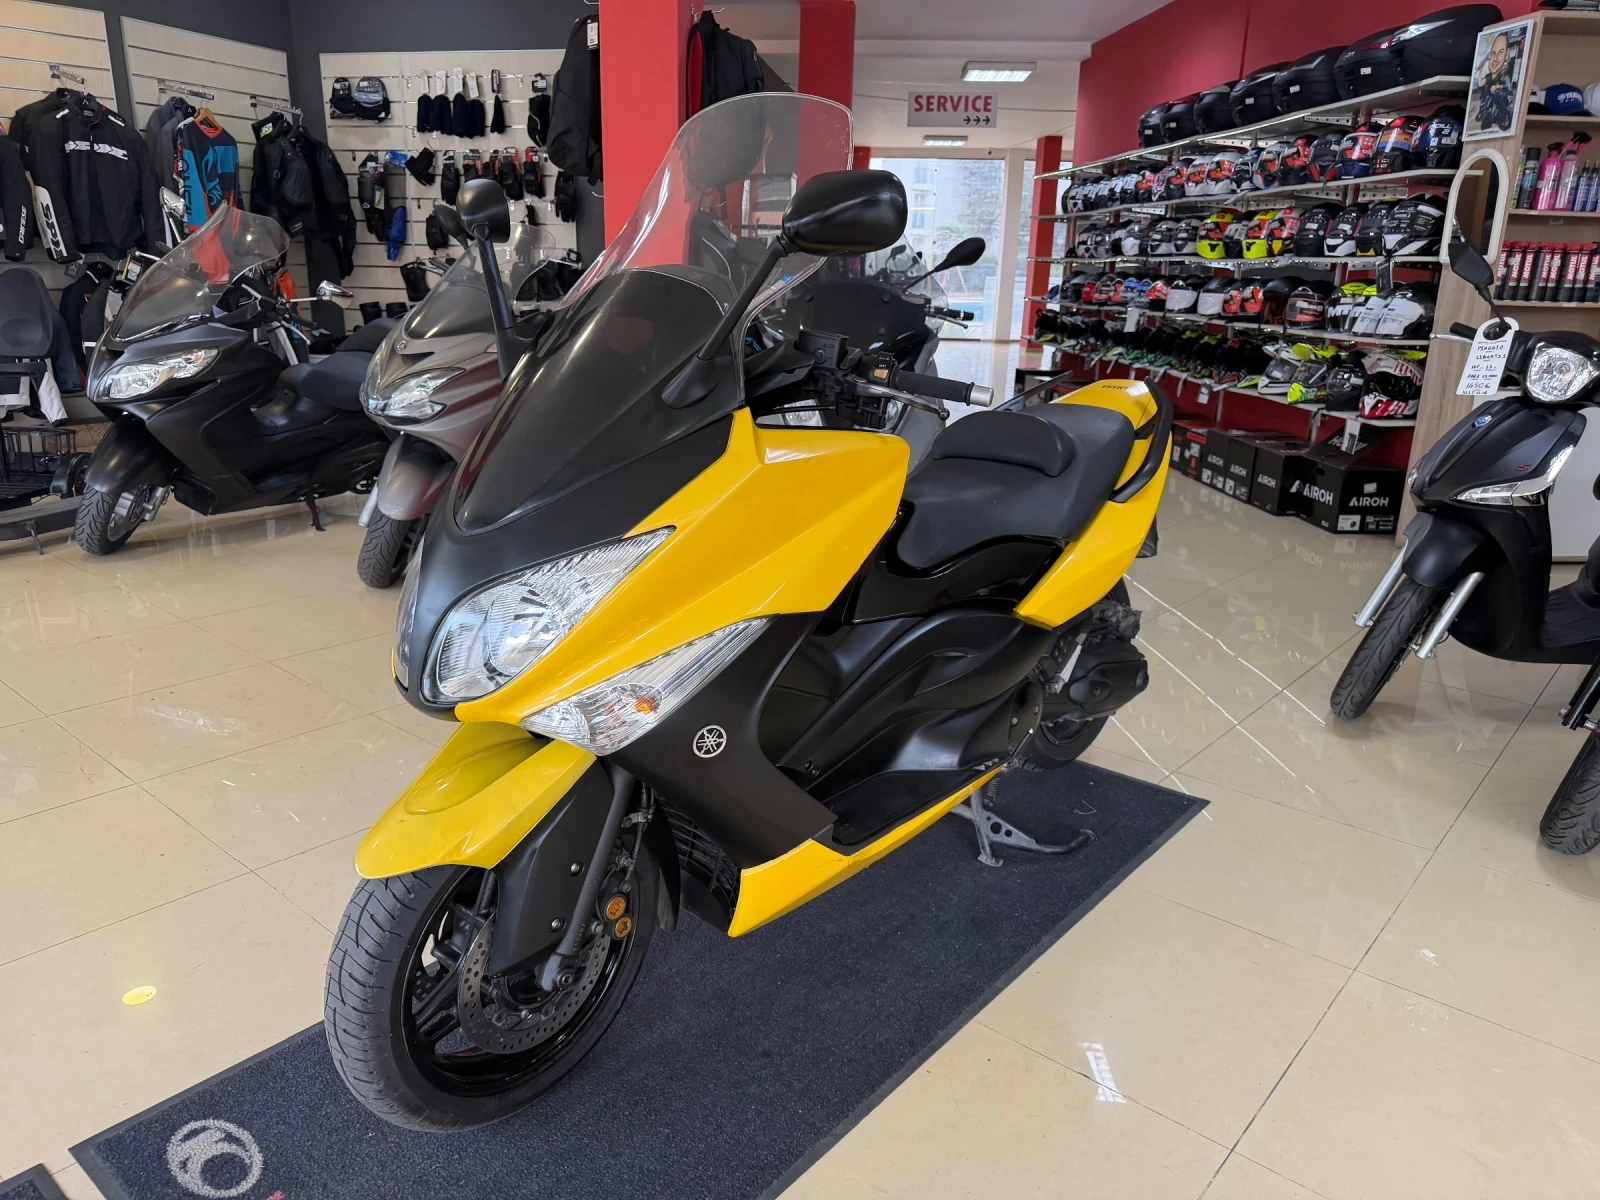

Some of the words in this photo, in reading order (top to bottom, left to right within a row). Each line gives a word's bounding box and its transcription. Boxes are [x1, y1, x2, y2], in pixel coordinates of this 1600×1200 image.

[914, 95, 992, 113] SERVICE
[1511, 253, 1522, 278] MOUL
[1522, 253, 1533, 279] MOTUL
[1541, 253, 1552, 278] MOTUL
[1566, 254, 1578, 280] MOTUL
[1577, 254, 1588, 279] OTUL
[1207, 453, 1224, 467] AIROH
[1230, 463, 1248, 478] AIROH
[1257, 473, 1277, 489] AIROH
[1303, 483, 1334, 506] AIROH
[1348, 497, 1389, 507] AIROH
